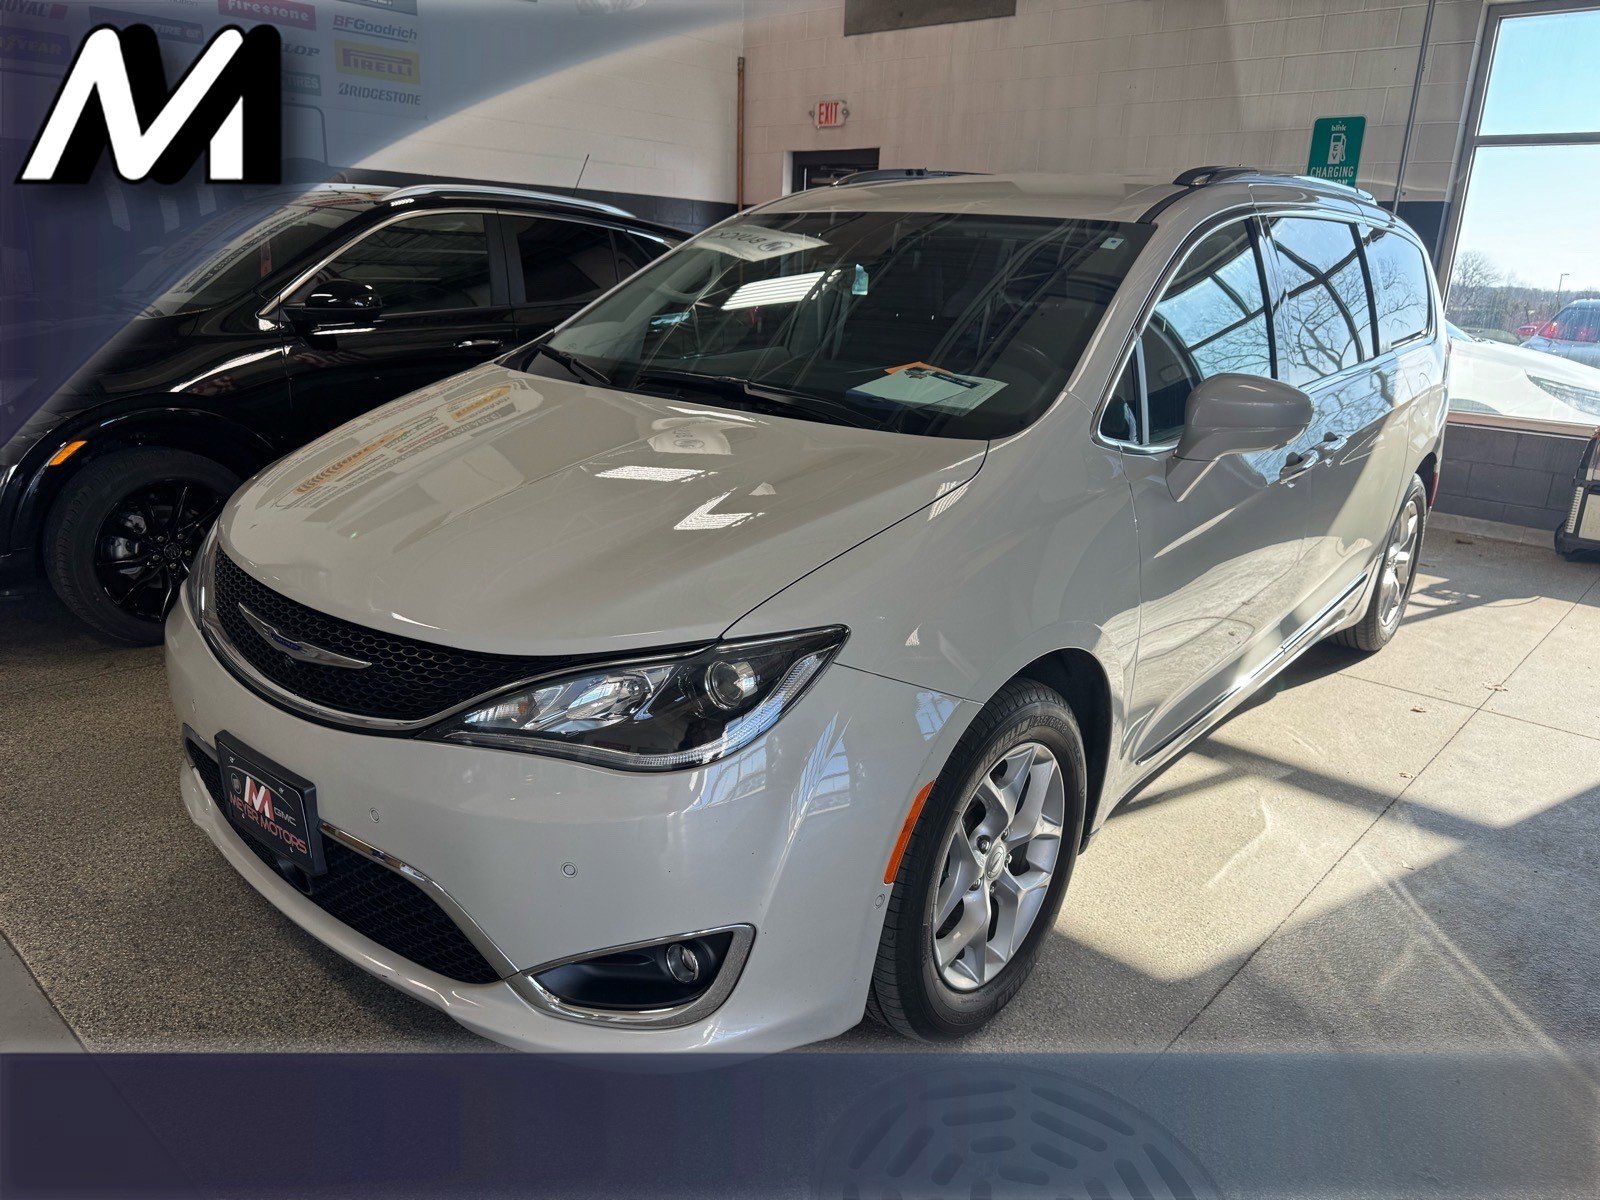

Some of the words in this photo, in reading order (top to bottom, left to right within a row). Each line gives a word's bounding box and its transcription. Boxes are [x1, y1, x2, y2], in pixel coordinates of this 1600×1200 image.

[227, 0, 309, 21] Firestone
[333, 14, 418, 40] BFGoodrich
[342, 48, 413, 77] PIRELLI
[338, 82, 421, 106] BRIDGESTONE
[818, 102, 839, 125] EXIT
[1331, 124, 1347, 132] blink
[1310, 166, 1354, 178] CHARGING
[229, 791, 259, 825] MEYER
[260, 815, 307, 854] MOTORS
[273, 806, 297, 827] GMC
